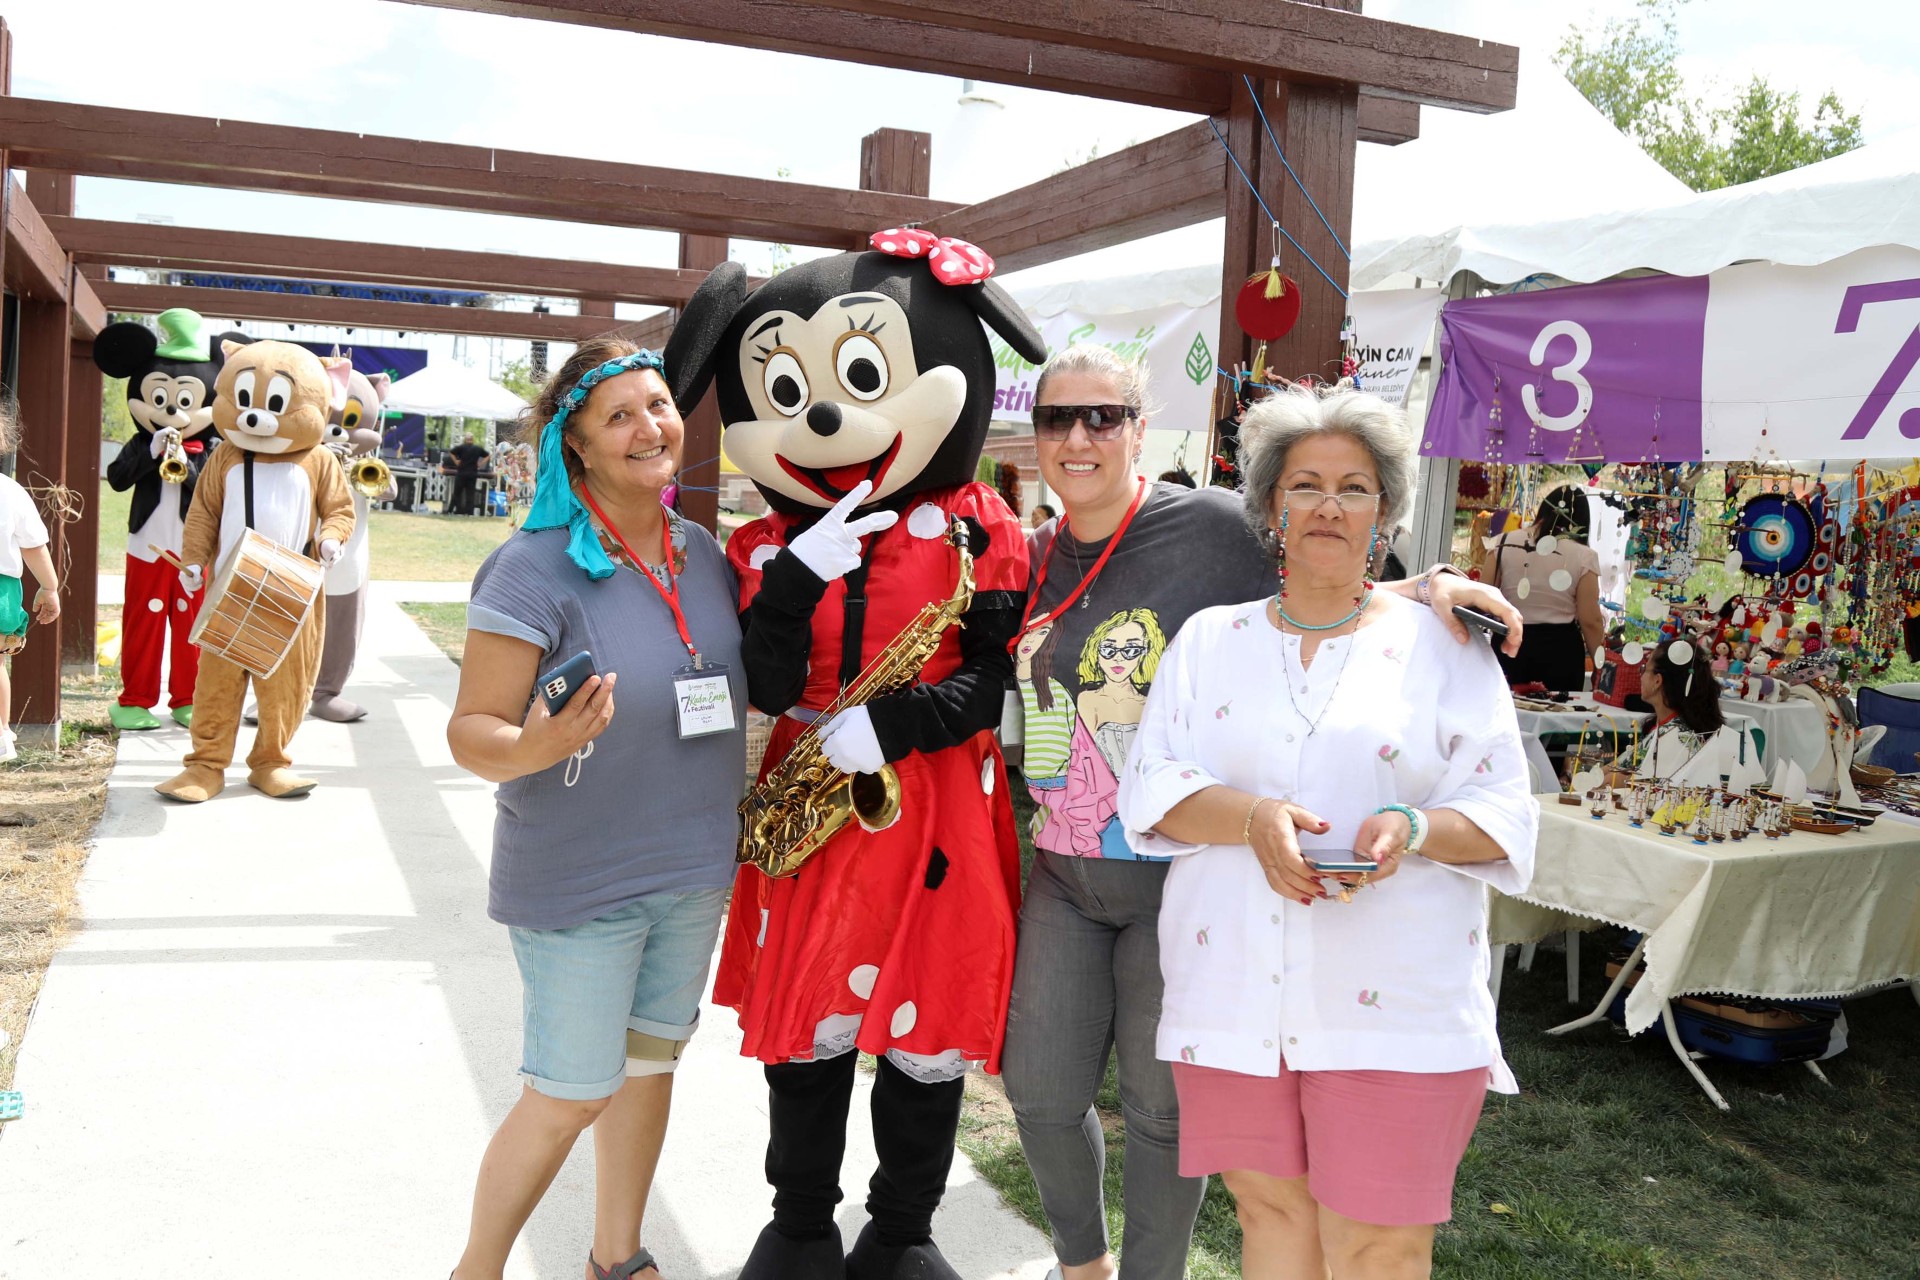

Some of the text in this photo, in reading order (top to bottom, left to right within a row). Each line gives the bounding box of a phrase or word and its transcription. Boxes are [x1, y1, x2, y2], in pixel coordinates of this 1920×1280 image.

[1386, 347, 1414, 362] CAN
[1834, 278, 1920, 440] 7.
[1359, 367, 1409, 379] üner
[1521, 320, 1593, 431] 3
[993, 381, 1036, 412] stiv
[691, 704, 715, 712] Festivali
